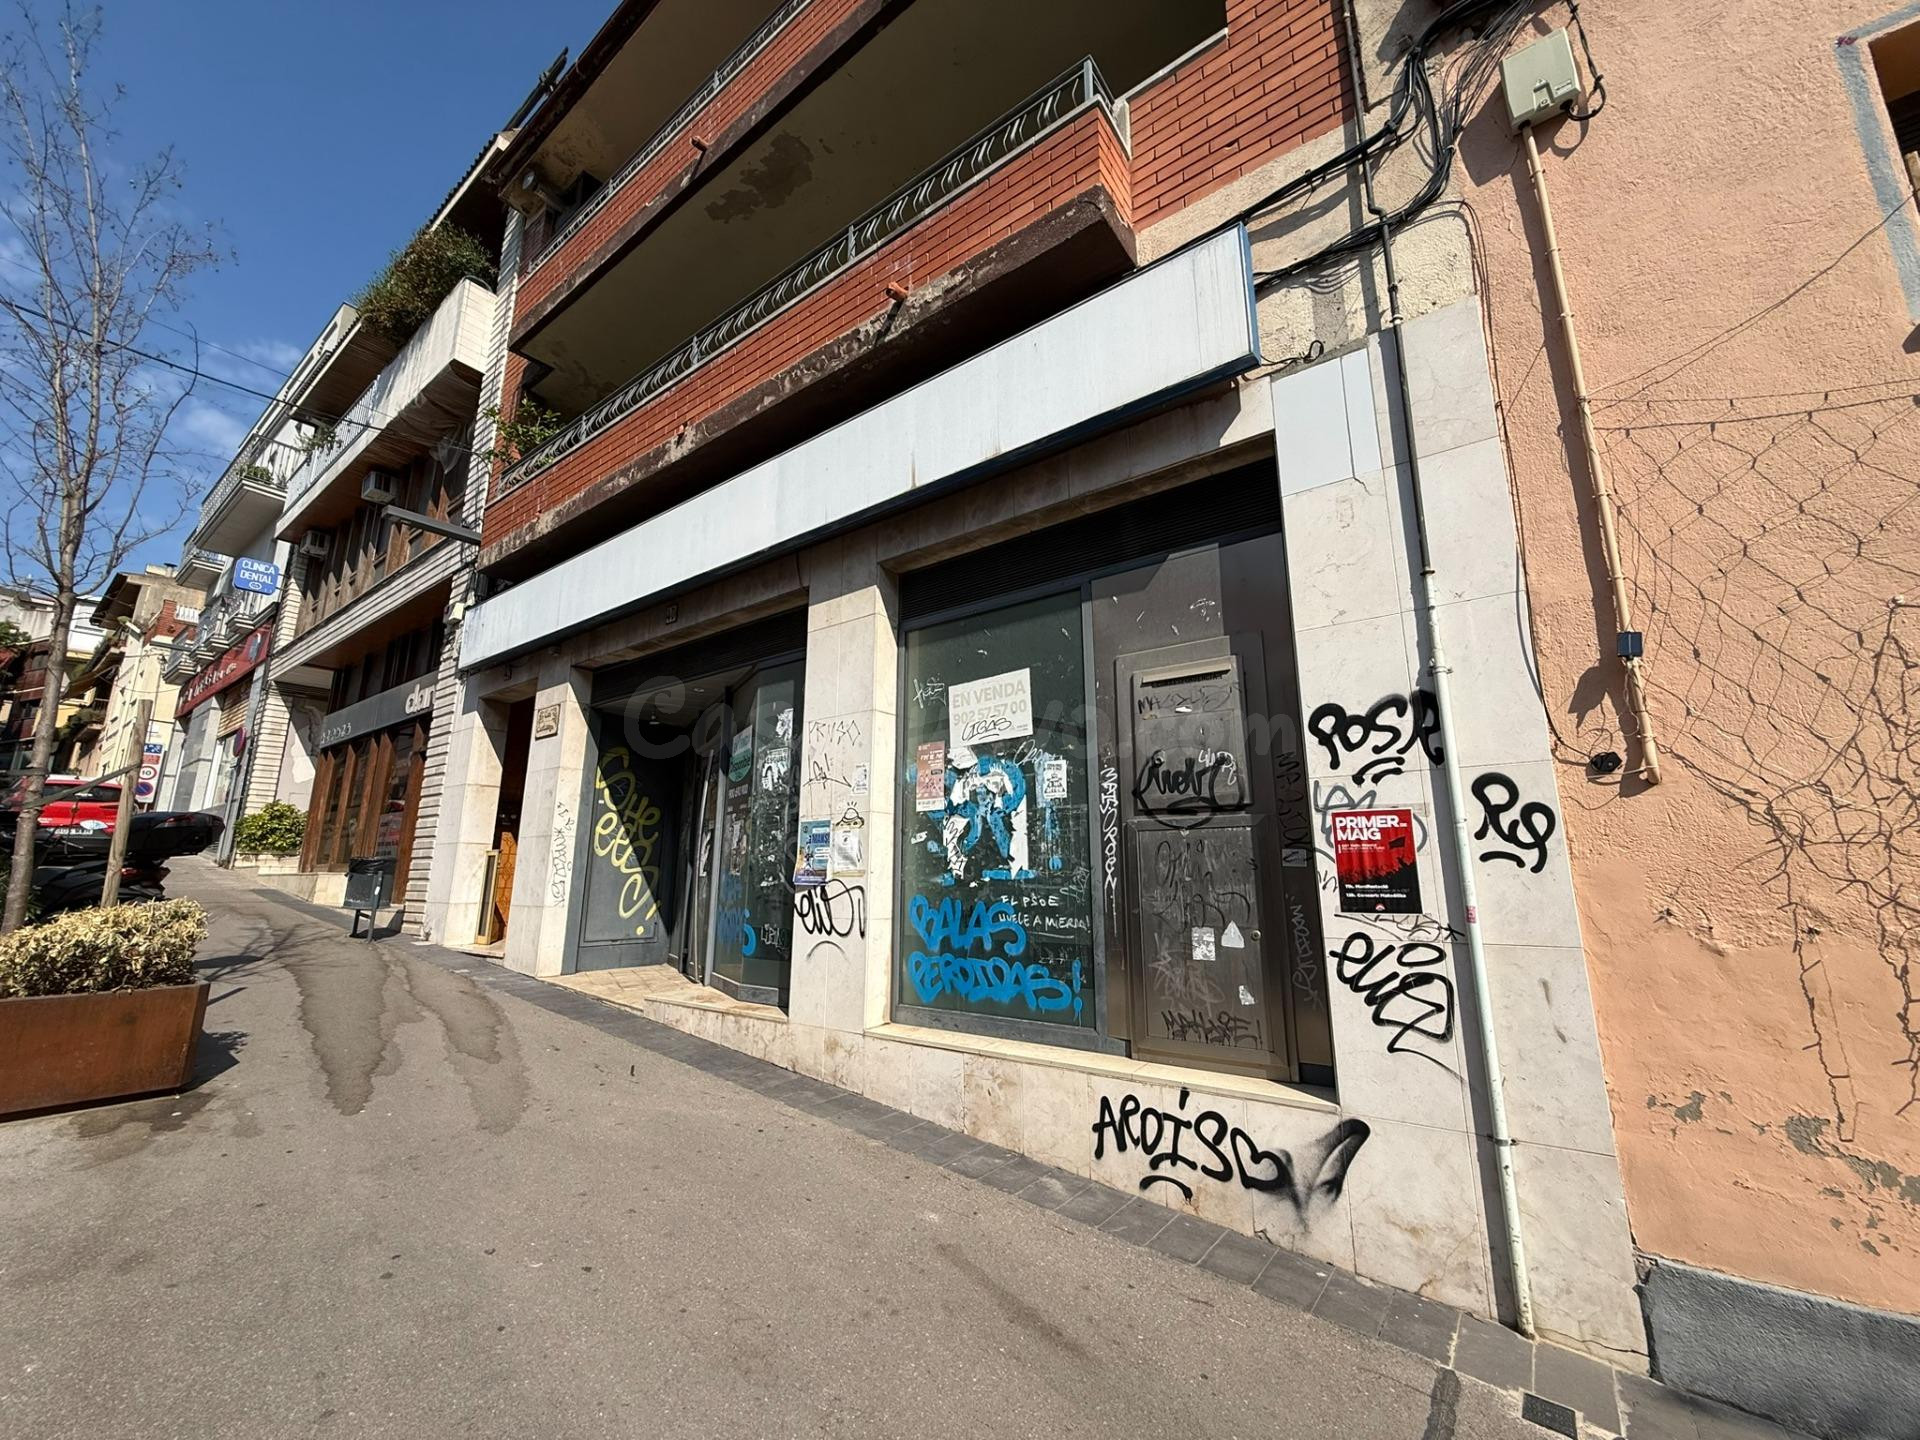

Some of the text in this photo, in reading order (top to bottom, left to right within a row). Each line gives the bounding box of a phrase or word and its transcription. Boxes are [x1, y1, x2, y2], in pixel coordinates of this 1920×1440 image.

[242, 560, 275, 575] CLINICA
[240, 569, 273, 585] DENTAL
[952, 690, 970, 708] EN
[974, 680, 1026, 704] VENDA
[953, 699, 1027, 726] 902 57 57 00
[1335, 815, 1400, 829] PRIMER
[1337, 827, 1382, 841] MAIG
[1001, 892, 1060, 908] EL PSOE
[909, 894, 1027, 956] BALAS
[1032, 915, 1042, 928] A
